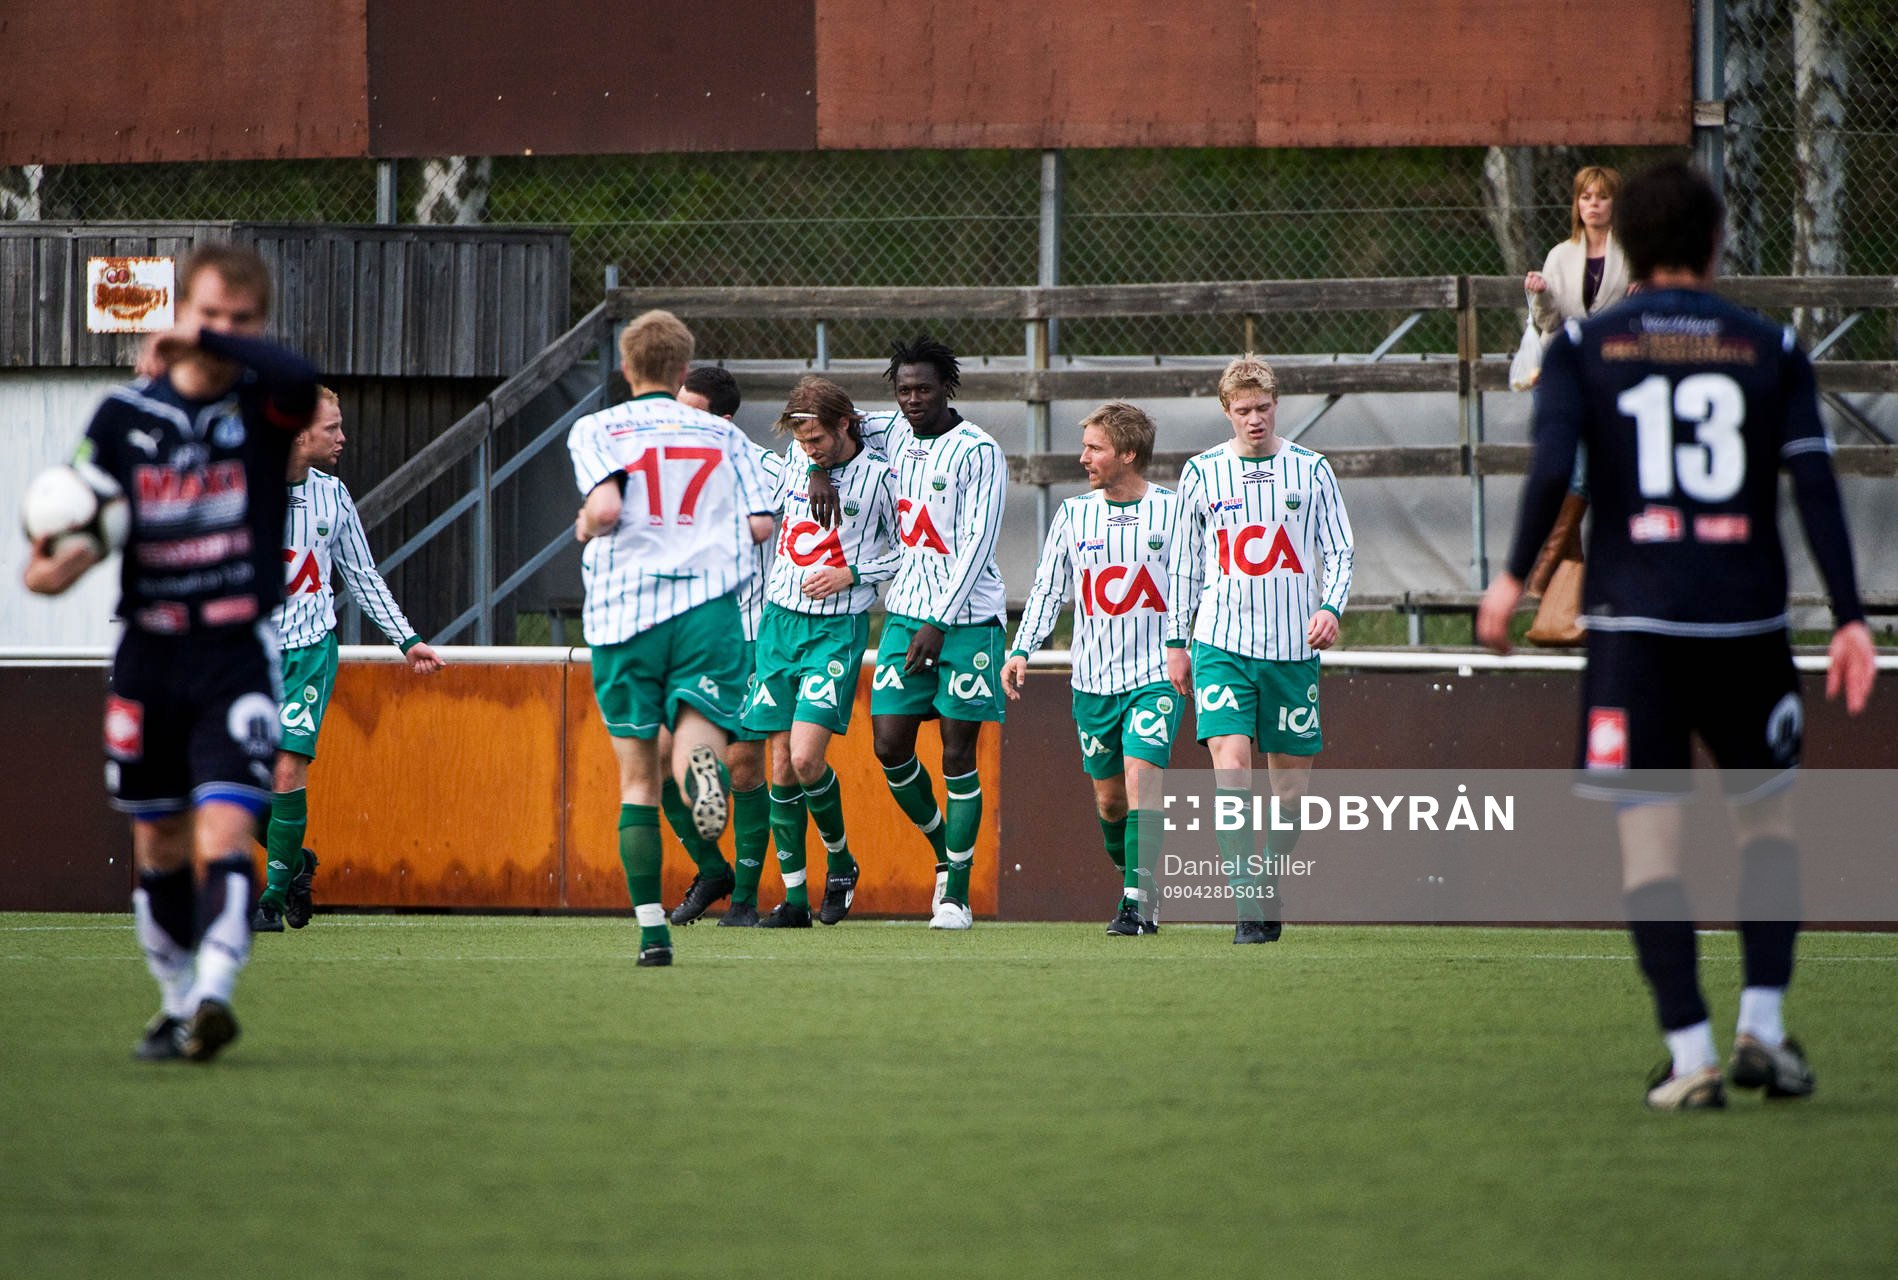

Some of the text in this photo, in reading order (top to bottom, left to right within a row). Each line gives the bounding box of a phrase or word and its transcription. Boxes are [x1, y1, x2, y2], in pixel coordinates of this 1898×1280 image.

[1617, 372, 1747, 502] 13
[624, 446, 723, 526] 17
[896, 498, 951, 555] CA
[1216, 523, 1305, 577] ICA
[1082, 563, 1168, 617] ICA
[799, 675, 838, 707] ICA
[872, 664, 905, 691] CA
[947, 670, 993, 699] ICA
[1196, 683, 1240, 714] ICA
[280, 701, 316, 732] CA
[1128, 707, 1169, 743] ICA
[1080, 730, 1112, 758] CA
